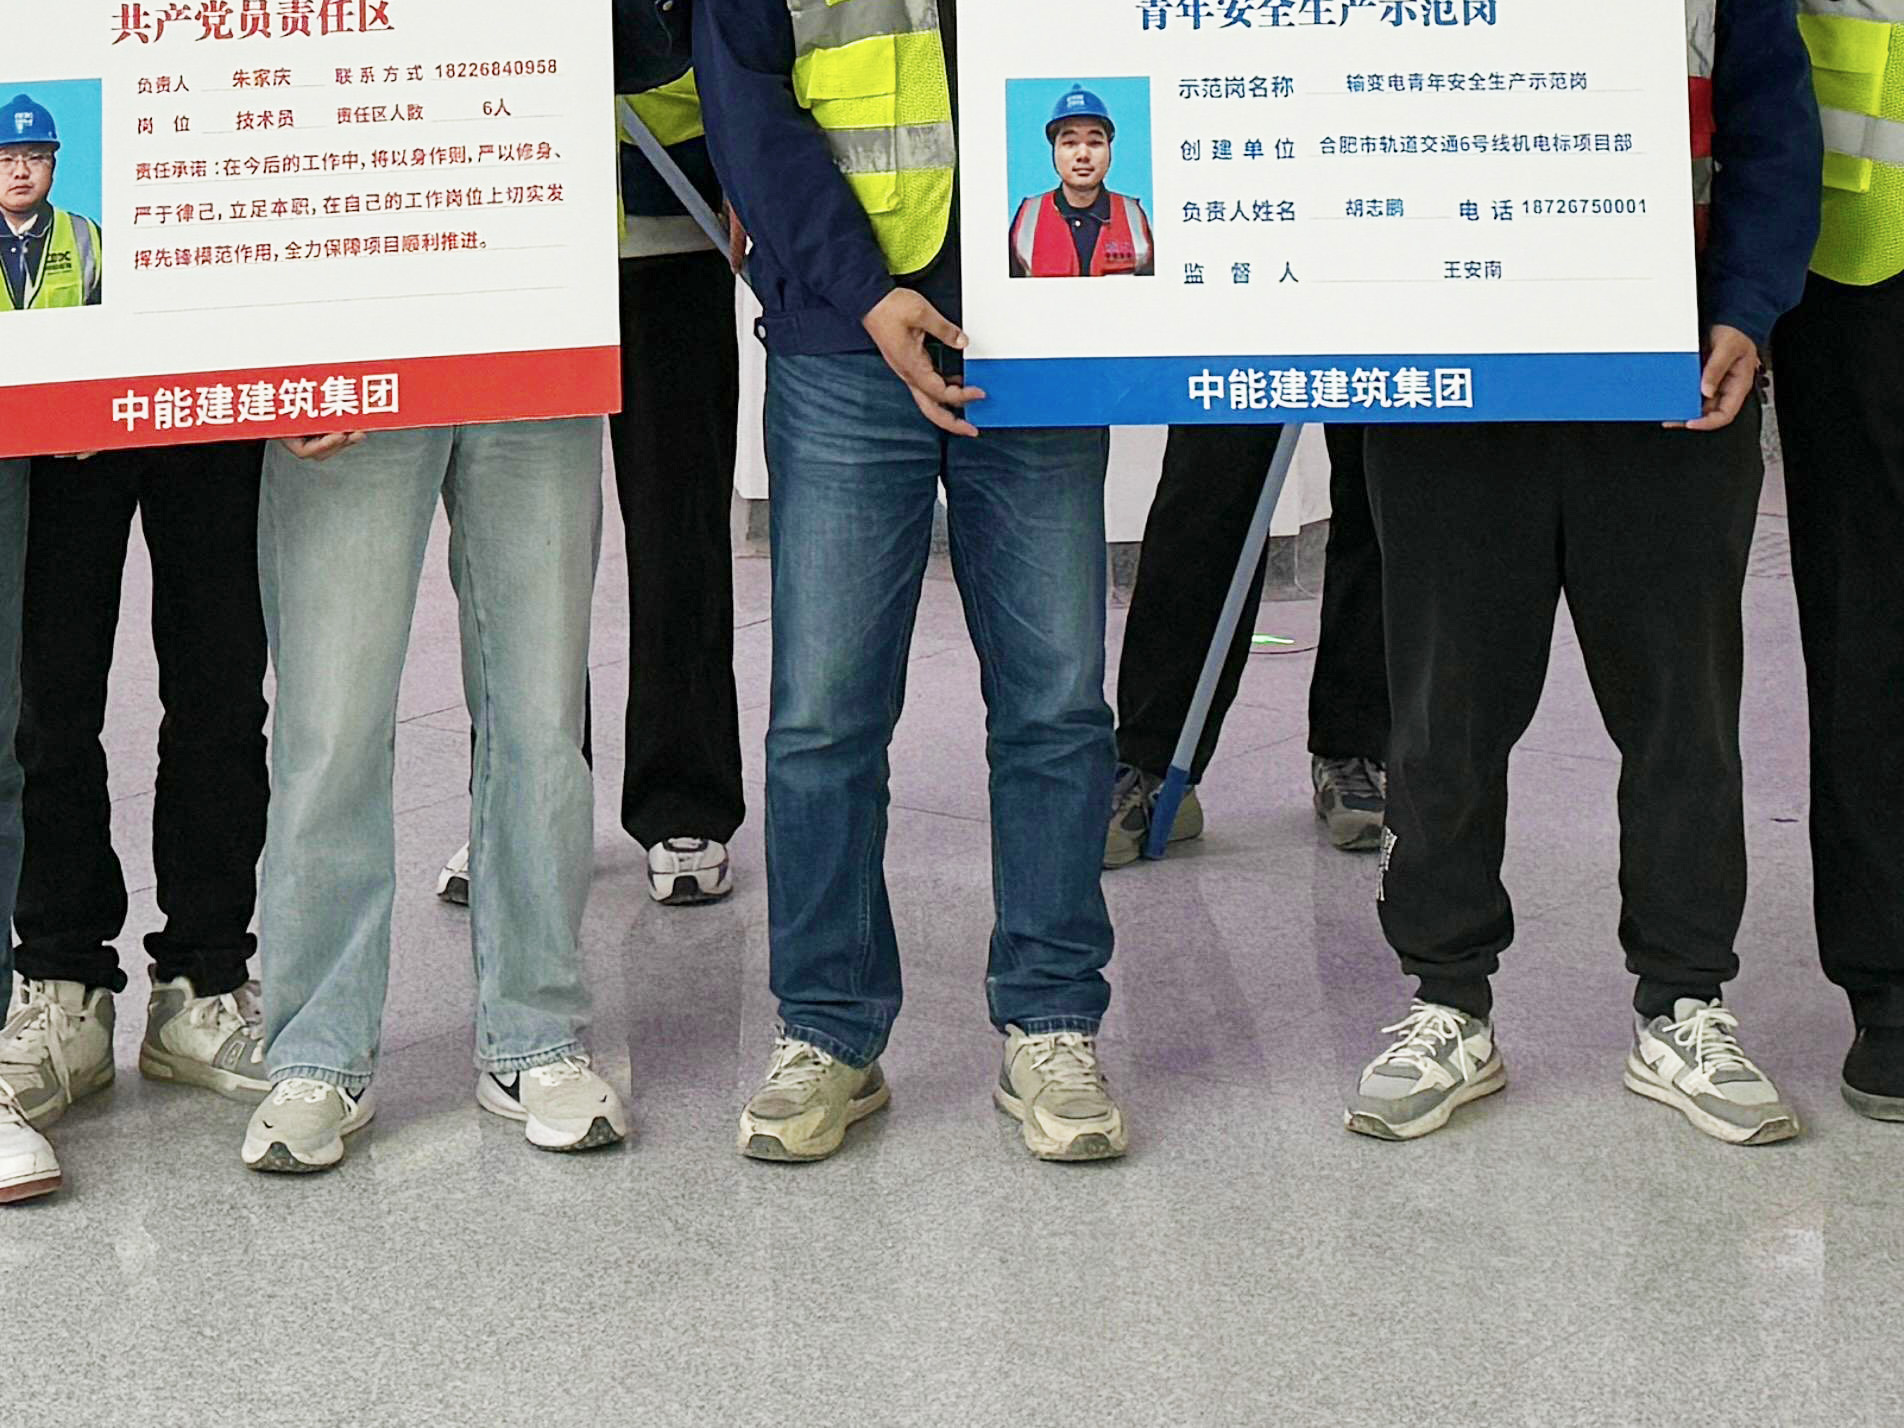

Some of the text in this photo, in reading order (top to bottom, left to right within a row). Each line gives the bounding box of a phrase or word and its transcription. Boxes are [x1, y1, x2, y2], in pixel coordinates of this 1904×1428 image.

[137, 74, 190, 94] 负责人
[335, 64, 424, 85] 联系方式
[435, 58, 558, 79] 18226840958
[1179, 72, 1588, 99] 示范岗名称 输变电青年安全生产示范岗
[138, 98, 512, 135] 岗位 技术员 责任区人数 6人
[1181, 133, 1633, 162] 创建单位 合肥市轨道交通6号线机电标项目部
[1181, 198, 1646, 223] 负责人姓名 胡志鹏 电话 18726750001
[1443, 261, 1502, 280] 王安南
[112, 373, 399, 432] 中能建建筑集团
[1189, 368, 1473, 409] 中能建建筑集团
